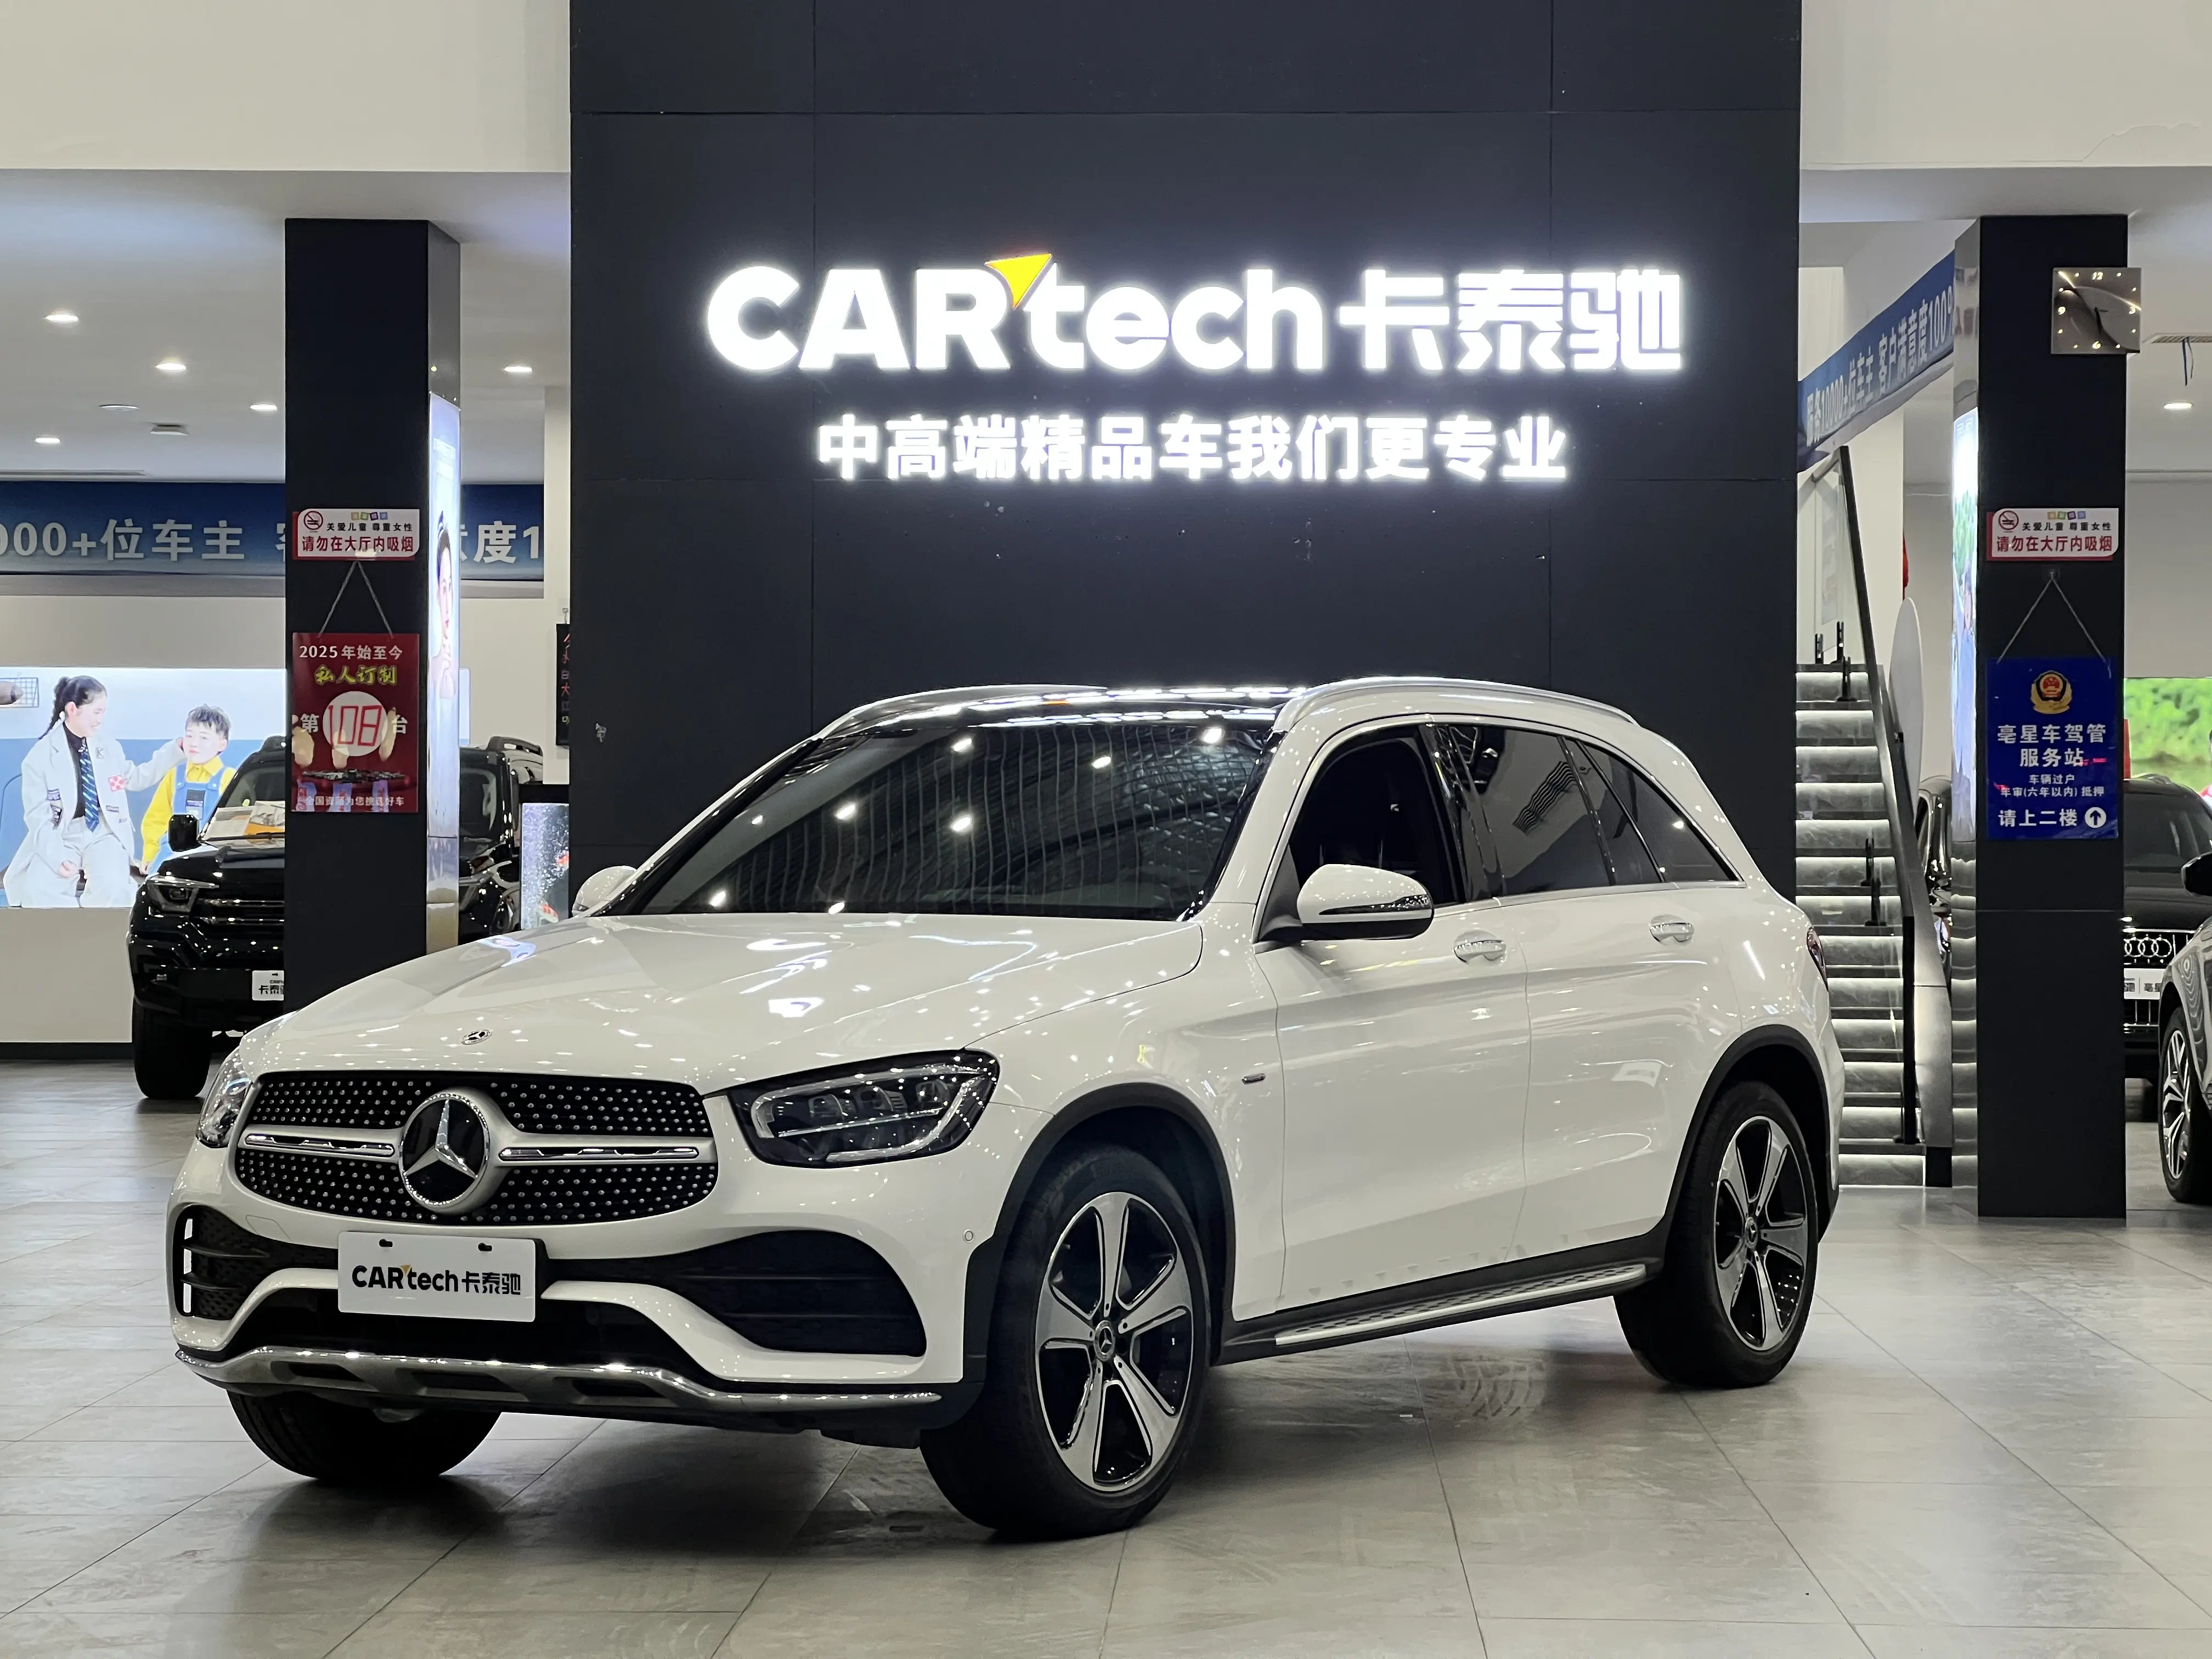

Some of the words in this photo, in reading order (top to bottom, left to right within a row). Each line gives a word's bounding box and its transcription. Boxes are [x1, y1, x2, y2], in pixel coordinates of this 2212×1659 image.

[2091, 272, 2103, 280] 12
[706, 264, 1323, 371] CARtech
[1339, 268, 1681, 371] 卡泰驰
[2092, 341, 2101, 349] 6
[819, 413, 1566, 481] 中高端精品车我们更专业
[326, 522, 367, 532] 关爱儿童
[372, 522, 413, 532] 尊重女性
[2022, 522, 2064, 531] 关爱儿童
[2069, 522, 2112, 531] 尊重女性
[302, 535, 413, 552] 请勿在大厅内吸烟
[1996, 535, 2113, 552] 请勿在大厅内吸烟
[315, 665, 396, 684] 私人订制
[301, 714, 319, 733] 第
[329, 704, 383, 747] 108
[391, 714, 408, 734] 台
[2019, 747, 2084, 767] 服务站
[2029, 774, 2075, 785] 车辆过户
[2081, 786, 2104, 797] 抵押
[1998, 808, 2077, 827] 请上二楼
[352, 1264, 459, 1292] CARtech
[461, 1271, 521, 1295] 卡泰驰
